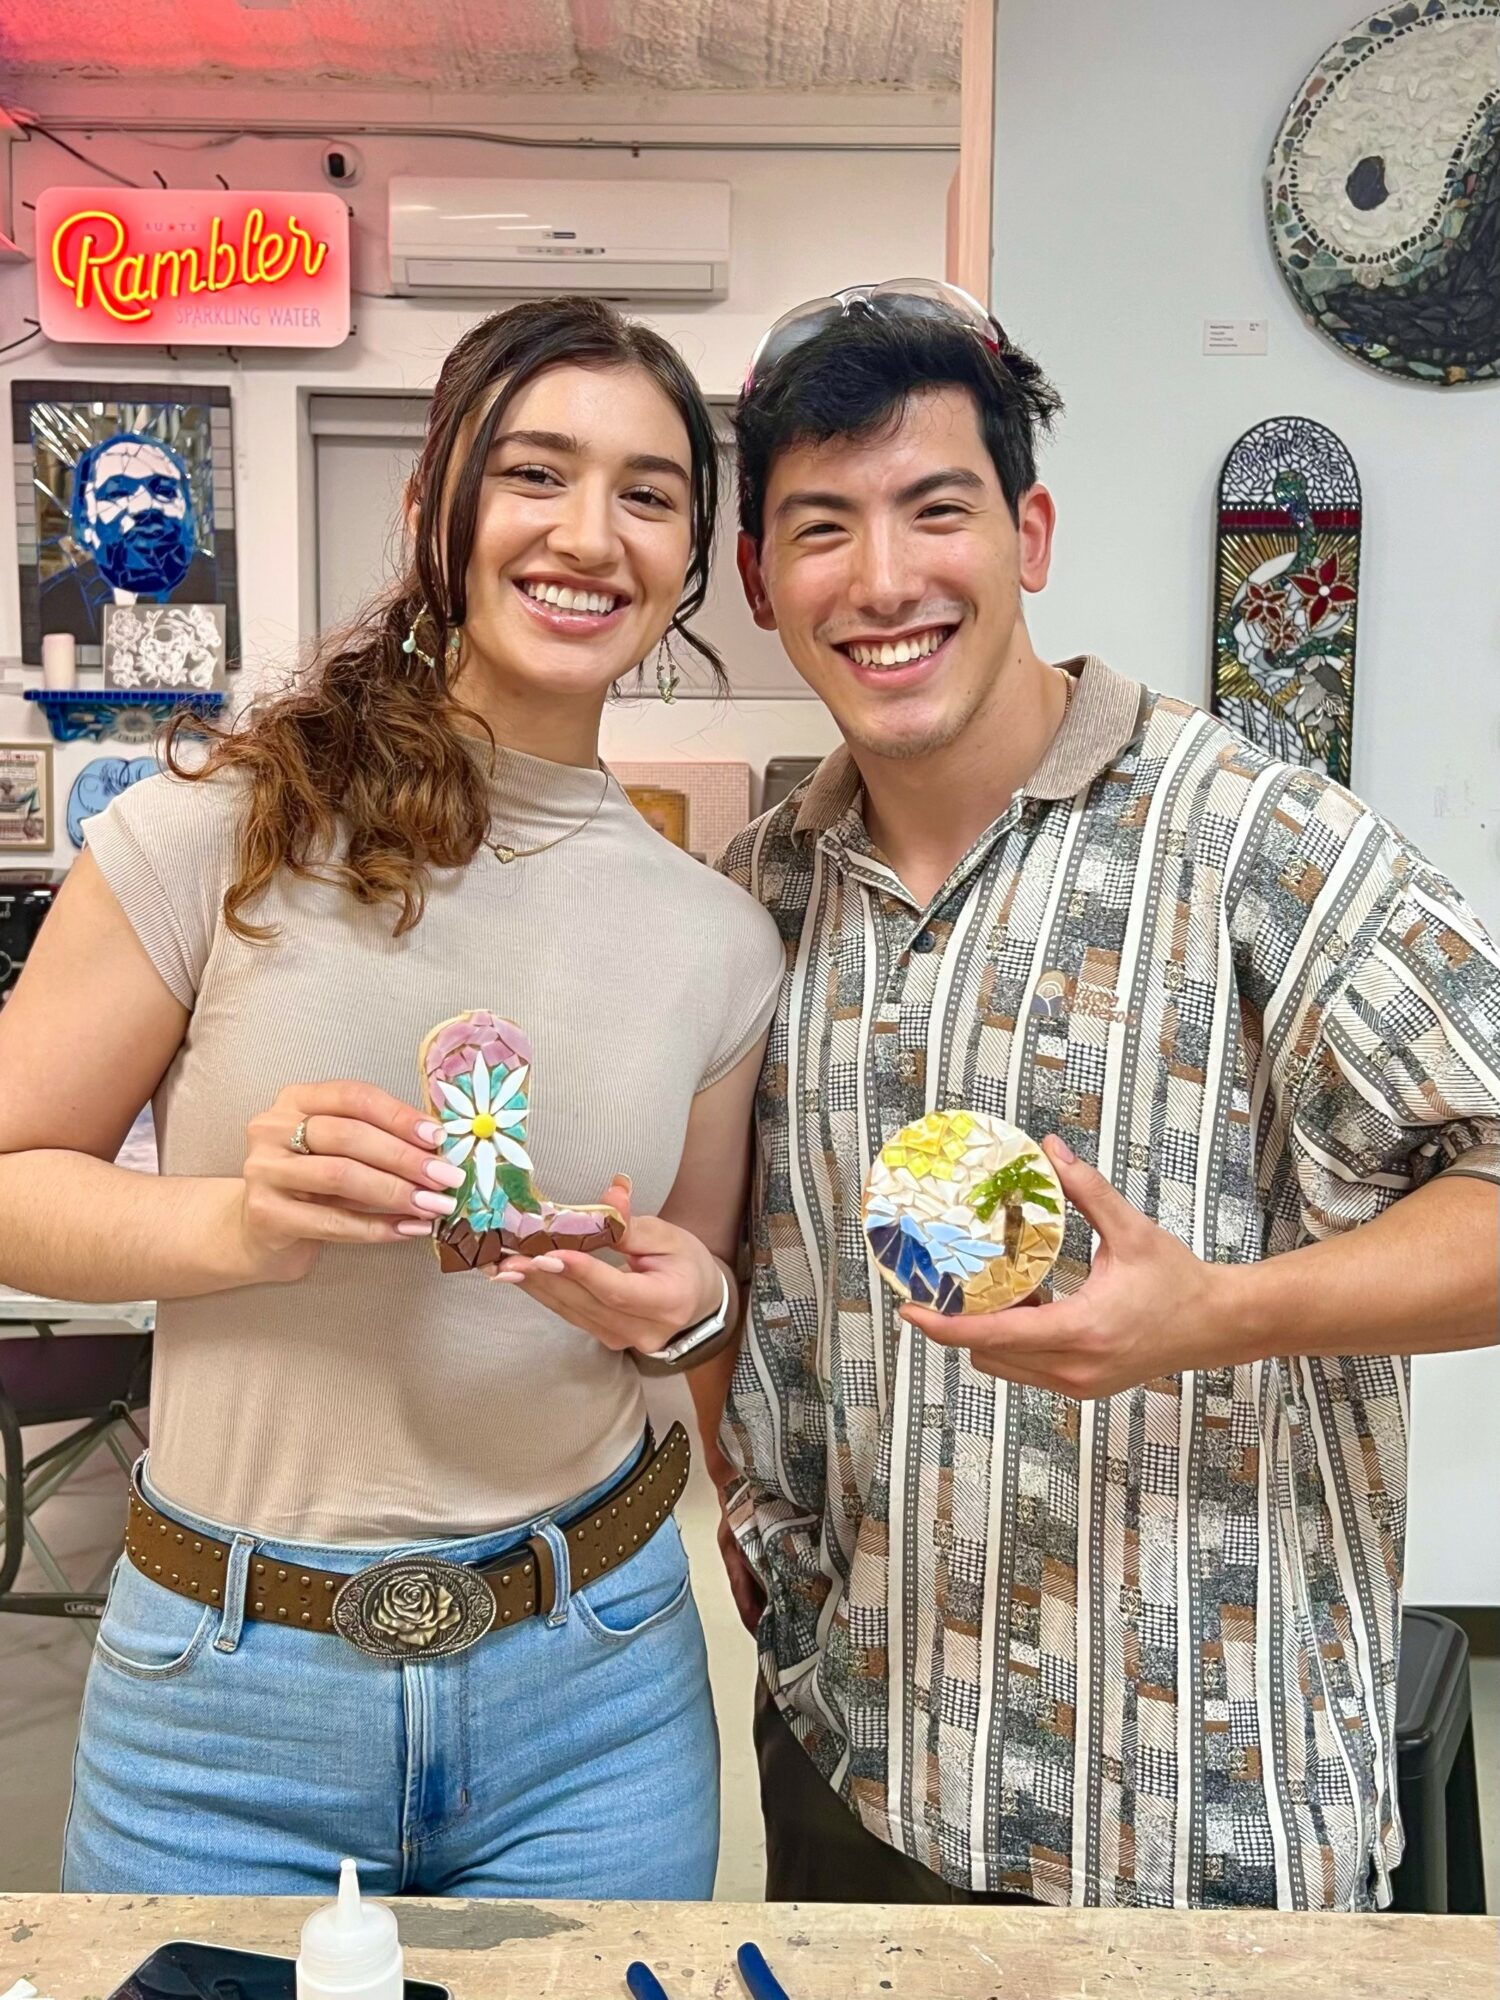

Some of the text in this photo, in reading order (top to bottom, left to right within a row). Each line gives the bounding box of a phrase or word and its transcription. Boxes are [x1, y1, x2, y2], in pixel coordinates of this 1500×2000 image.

[52, 208, 327, 321] Rambler
[177, 304, 322, 328] SPARKLING WATER
